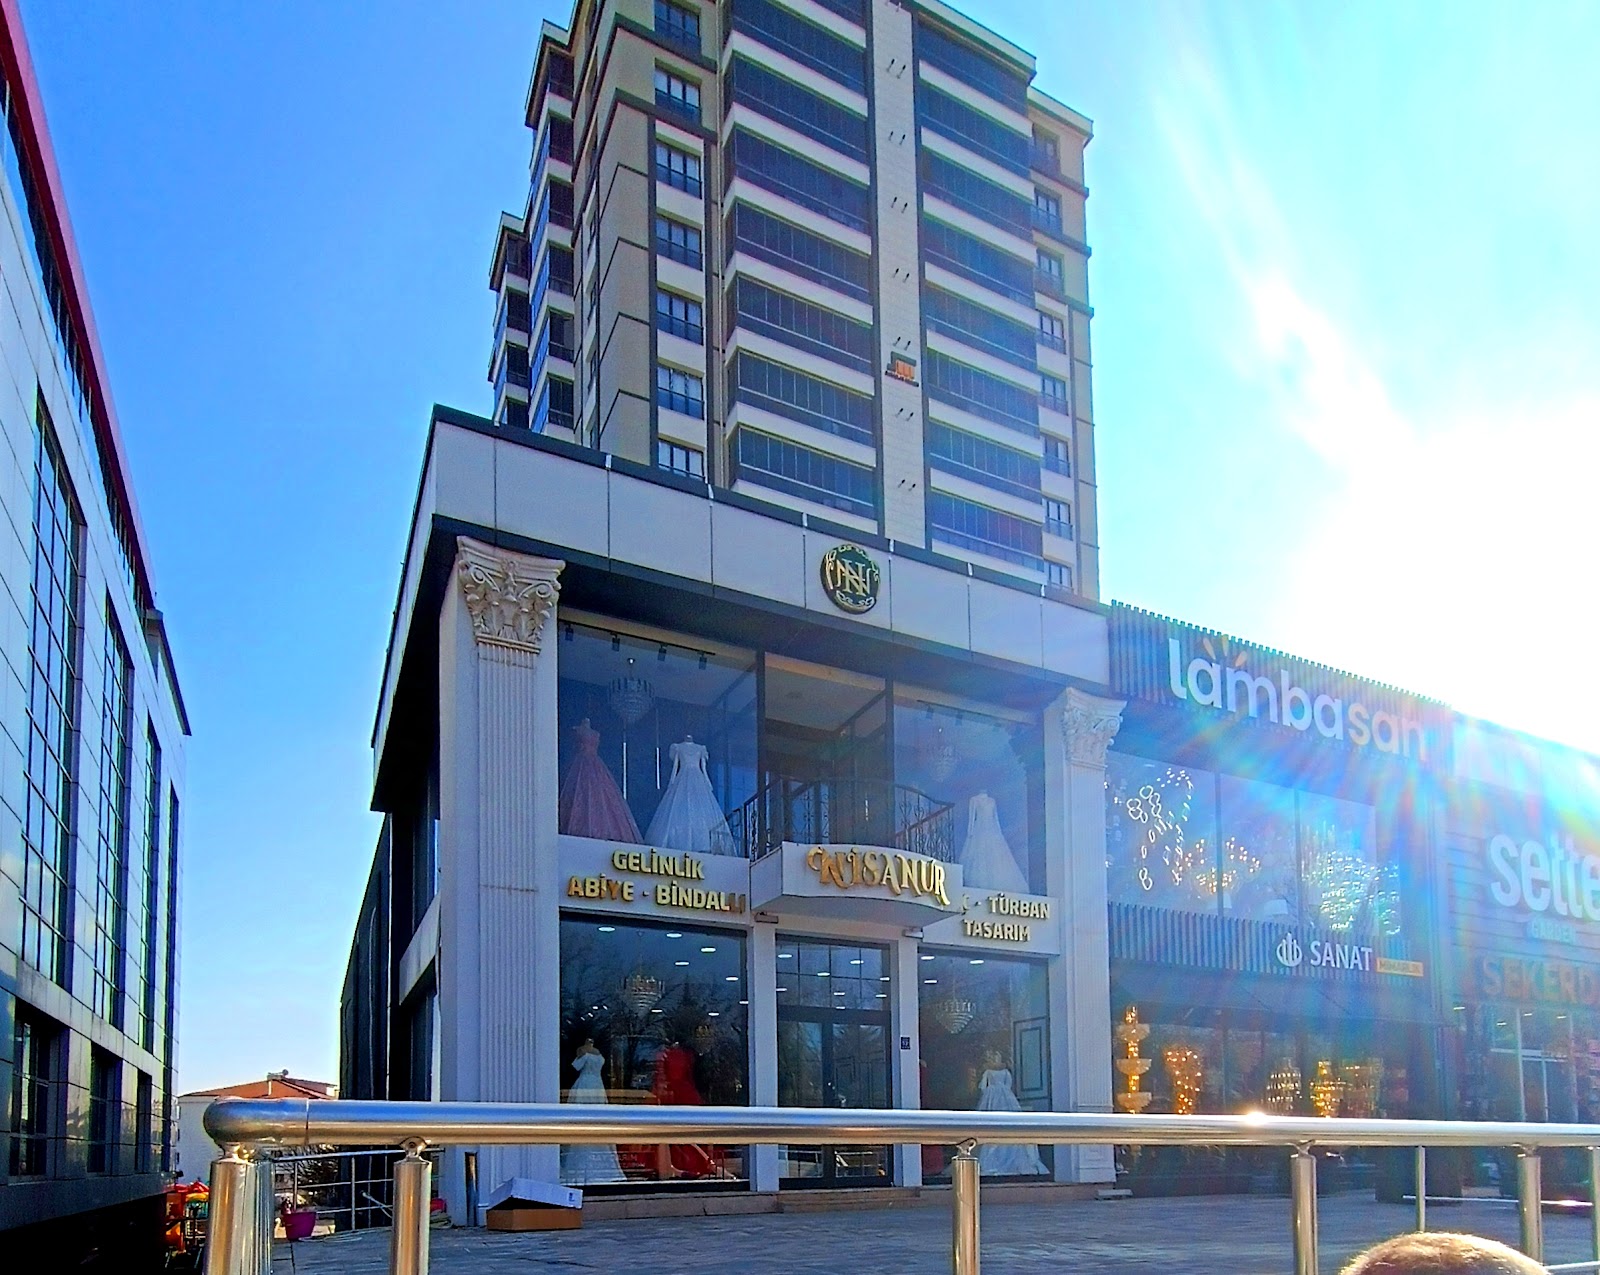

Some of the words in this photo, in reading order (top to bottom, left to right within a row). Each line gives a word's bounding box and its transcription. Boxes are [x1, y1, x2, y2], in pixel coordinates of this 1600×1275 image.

[1168, 637, 1427, 761] lambasan
[612, 848, 705, 880] GELİNLİK
[568, 873, 634, 901] ABİYE
[656, 880, 747, 914] BİNDALLI
[987, 892, 1050, 919] TÜRBAN
[962, 919, 1030, 942] TASARIM
[1310, 940, 1373, 972] SANAT
